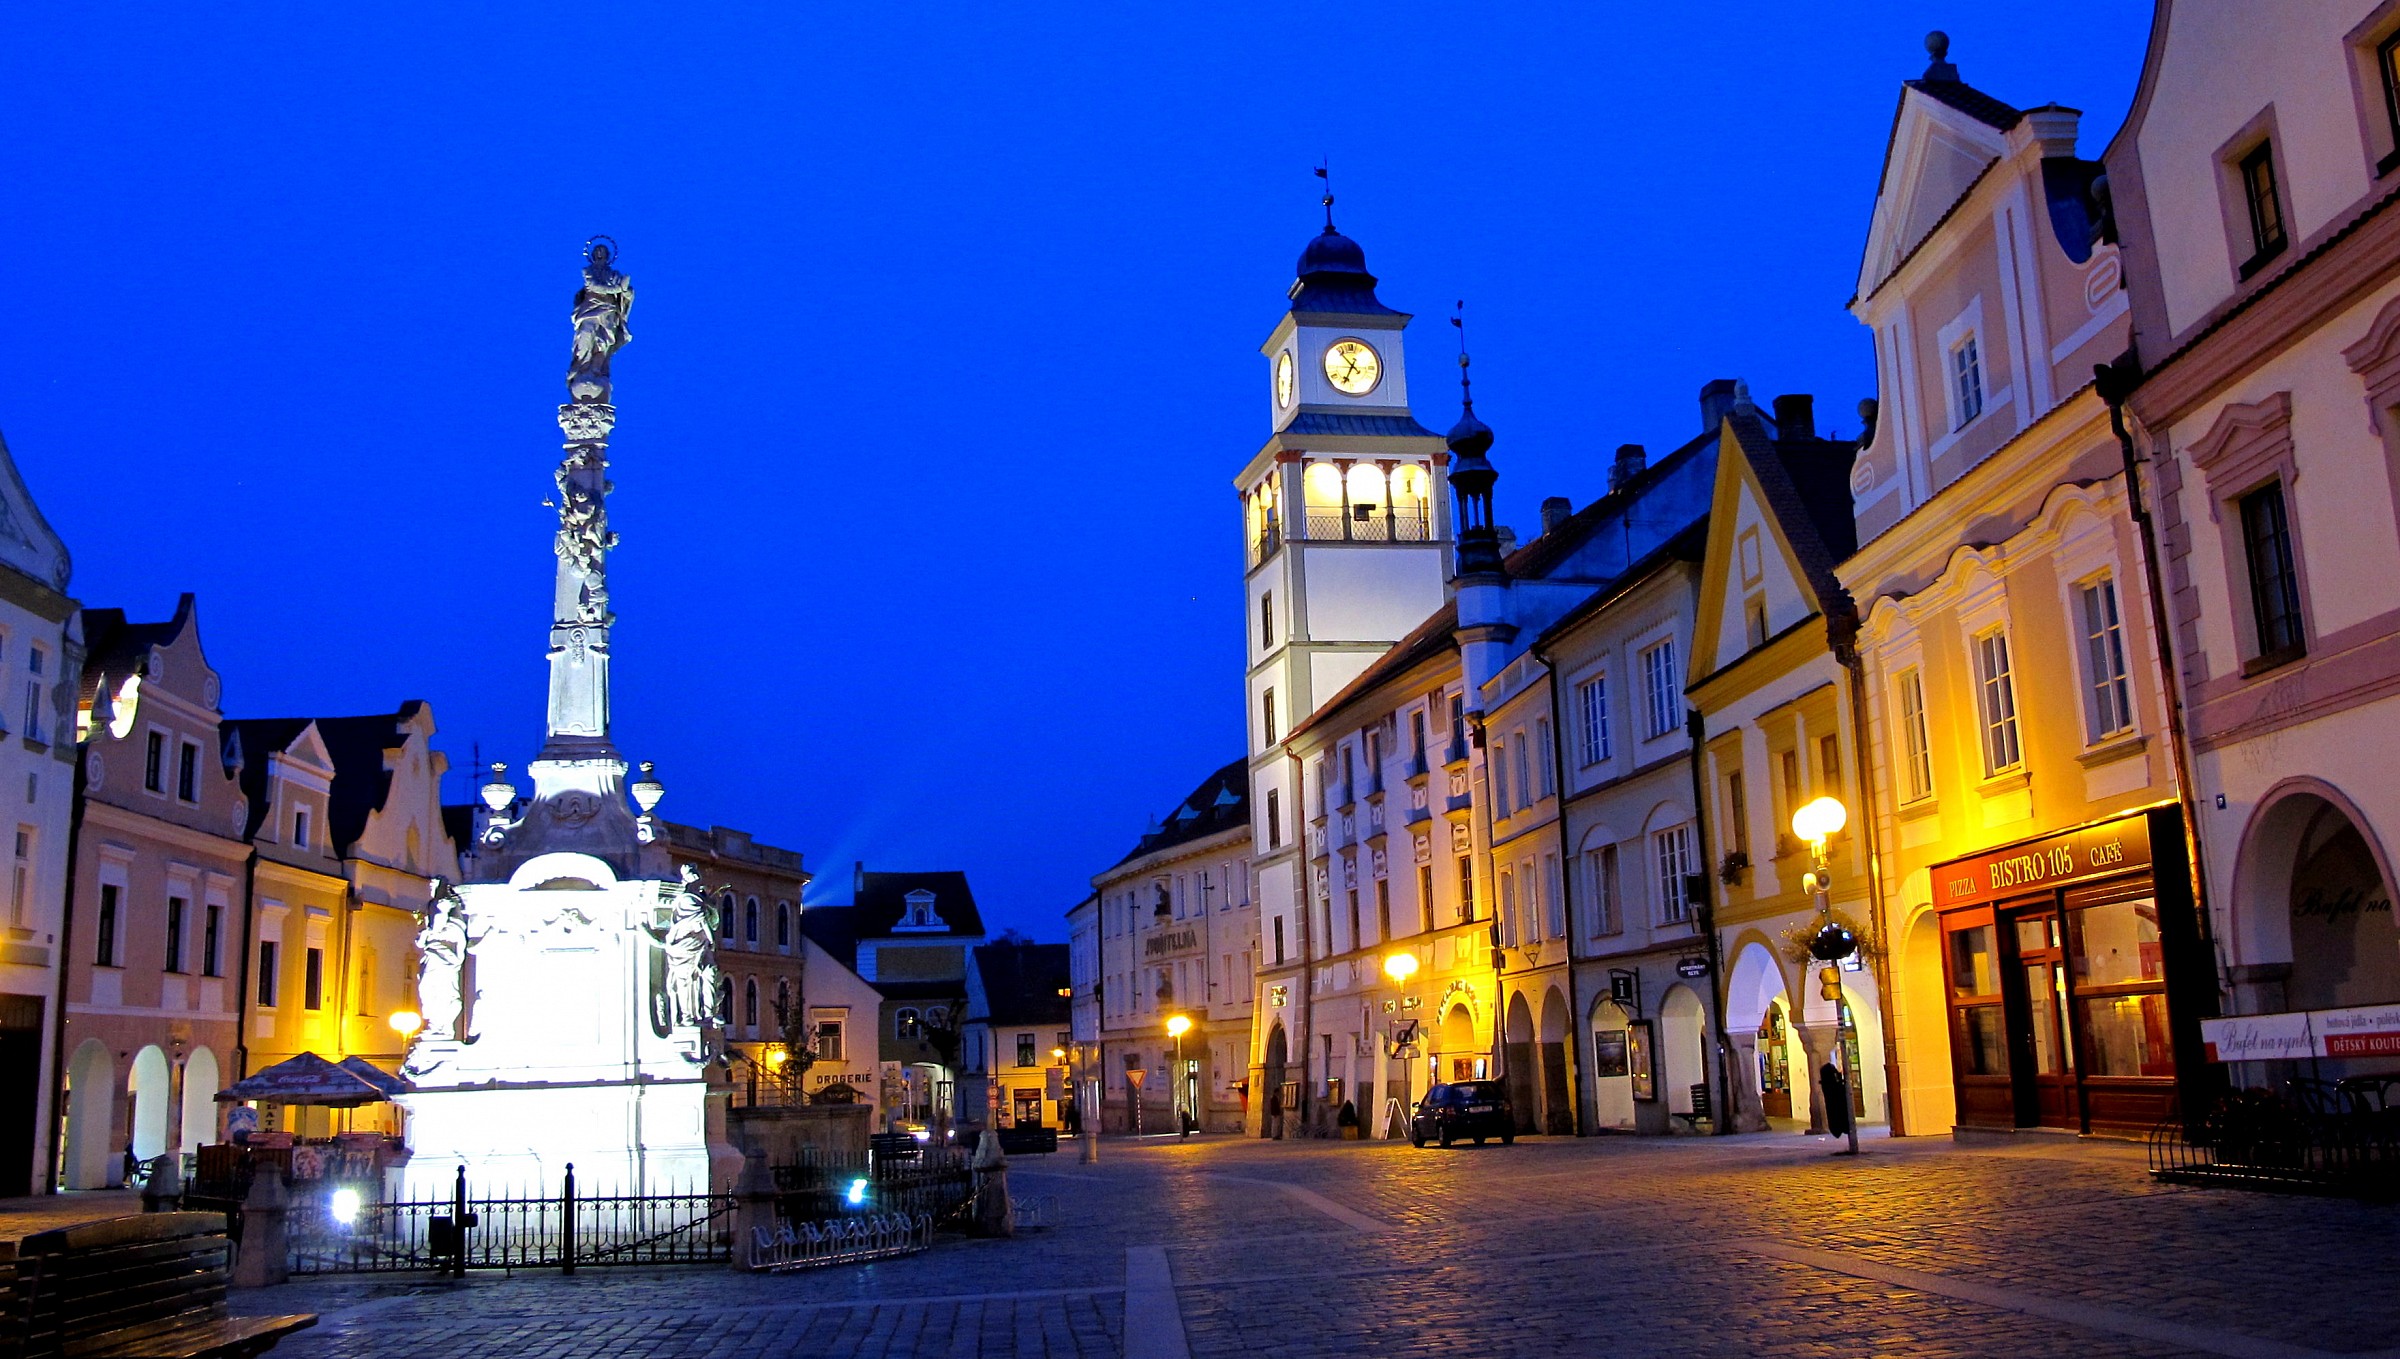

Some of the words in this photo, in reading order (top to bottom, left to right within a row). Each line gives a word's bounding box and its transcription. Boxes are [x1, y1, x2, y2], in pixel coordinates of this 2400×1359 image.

[1949, 876, 1977, 898] PIZZA
[1988, 851, 2046, 889] BISTRO
[2047, 843, 2074, 877] 105
[2089, 837, 2123, 867] CAFÉ
[2366, 899, 2392, 912] na
[2220, 1021, 2259, 1057] Bufet
[2261, 1037, 2275, 1050] na
[2333, 1035, 2366, 1052] DĚTSKÝ
[816, 1073, 872, 1084] DROGERIE
